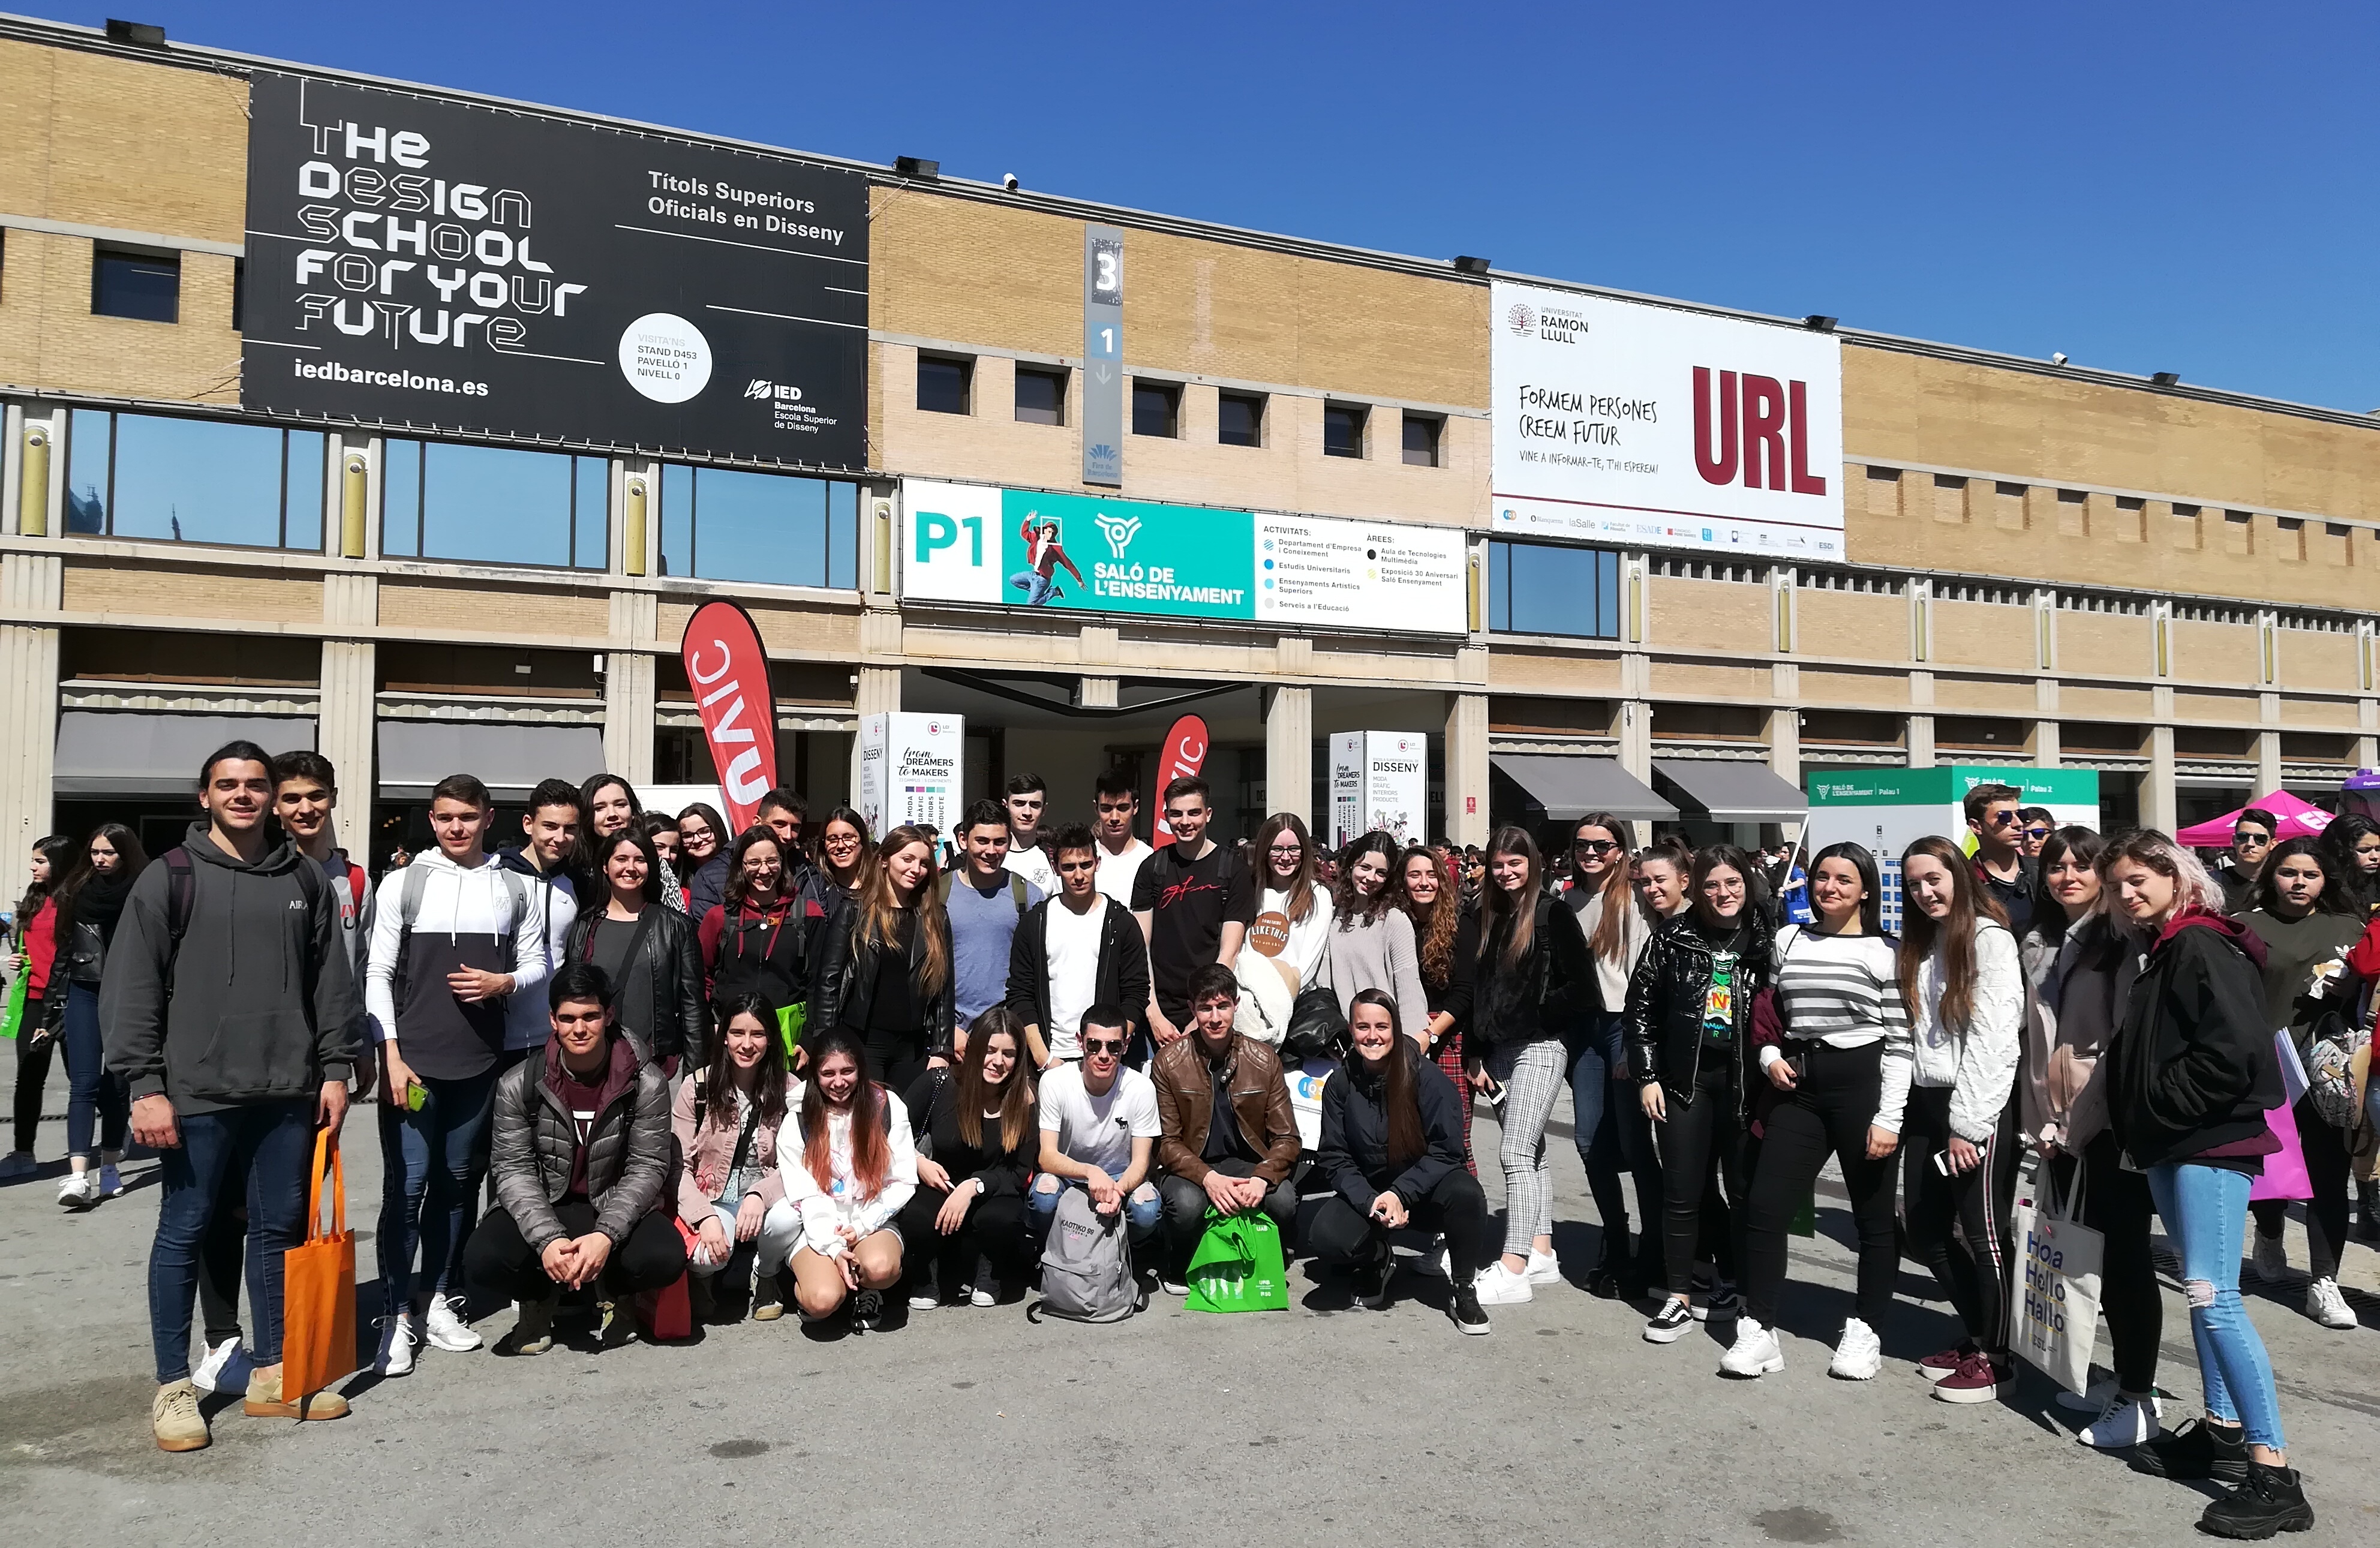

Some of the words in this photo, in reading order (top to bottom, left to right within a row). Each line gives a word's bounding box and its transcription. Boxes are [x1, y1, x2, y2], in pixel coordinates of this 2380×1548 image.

[648, 170, 709, 196] Títols
[715, 182, 815, 214] Superiors
[648, 196, 727, 224] Oficials
[734, 214, 758, 230] en
[765, 214, 844, 246] Disseny
[298, 204, 554, 273] SCHOOL
[1096, 252, 1117, 291] 3
[1541, 306, 1583, 318] UNIVERSITAT
[1541, 315, 1588, 333] RAMON
[1100, 328, 1113, 353] 1
[1541, 328, 1576, 344] LLULL
[637, 345, 671, 356] STAND
[674, 350, 697, 359] D453
[637, 356, 680, 369] PAVELLÓ
[295, 358, 489, 396] iedbarcelona.es
[637, 368, 672, 380] NIVELL
[774, 384, 803, 401] IED
[774, 401, 816, 414] Barcelona
[1519, 384, 1583, 413] FORMEM
[1589, 395, 1657, 423] PERSONES
[774, 411, 801, 421] Escola
[804, 414, 837, 426] Superior
[774, 421, 785, 429] de
[787, 422, 819, 434] Disseny
[1519, 414, 1567, 440] CREEM
[1573, 420, 1621, 446] FUTUR
[1693, 365, 1826, 497] URL
[1519, 450, 1538, 462] VINE
[1541, 452, 1547, 463] A
[1624, 461, 1659, 475] ESPEREM!
[1263, 525, 1311, 536] ACTIVITATS:
[1569, 518, 1595, 529] laSalle
[1636, 524, 1661, 535] ESADE
[915, 510, 983, 567] P1
[1366, 533, 1395, 543] ÀREES:
[1279, 539, 1324, 549] Departament
[1326, 543, 1362, 552] d'Empresa
[1283, 548, 1329, 557] Coneixement
[1381, 556, 1418, 564] Multimèdia
[1408, 550, 1447, 559] Tecnologies
[1093, 560, 1145, 582] SALÓ
[1149, 567, 1175, 584] DE
[1279, 562, 1305, 570] Estudis
[1307, 564, 1351, 574] Universitaris
[1381, 567, 1413, 576] Exposició
[1425, 571, 1459, 579] Aniversari
[1279, 578, 1330, 587] Ensenyaments
[1332, 582, 1360, 590] Artístics
[1398, 578, 1443, 586] Ensenyament
[1094, 579, 1245, 605] L'ENSENYAMENT
[1279, 586, 1313, 595] Superiors
[1314, 603, 1350, 612] l'Educació
[863, 747, 884, 761] DISSENY
[903, 746, 934, 761] from
[906, 758, 954, 767] DREAMERS
[1373, 762, 1419, 773] DISSENY
[896, 764, 911, 776] to
[912, 768, 949, 777] MAKERS
[1251, 925, 1270, 936] LIKE
[1270, 927, 1288, 942] THIS
[1060, 1219, 1086, 1233] KAOTIKO
[2025, 1259, 2066, 1303] Hello
[2024, 1288, 2065, 1333] Hallo
